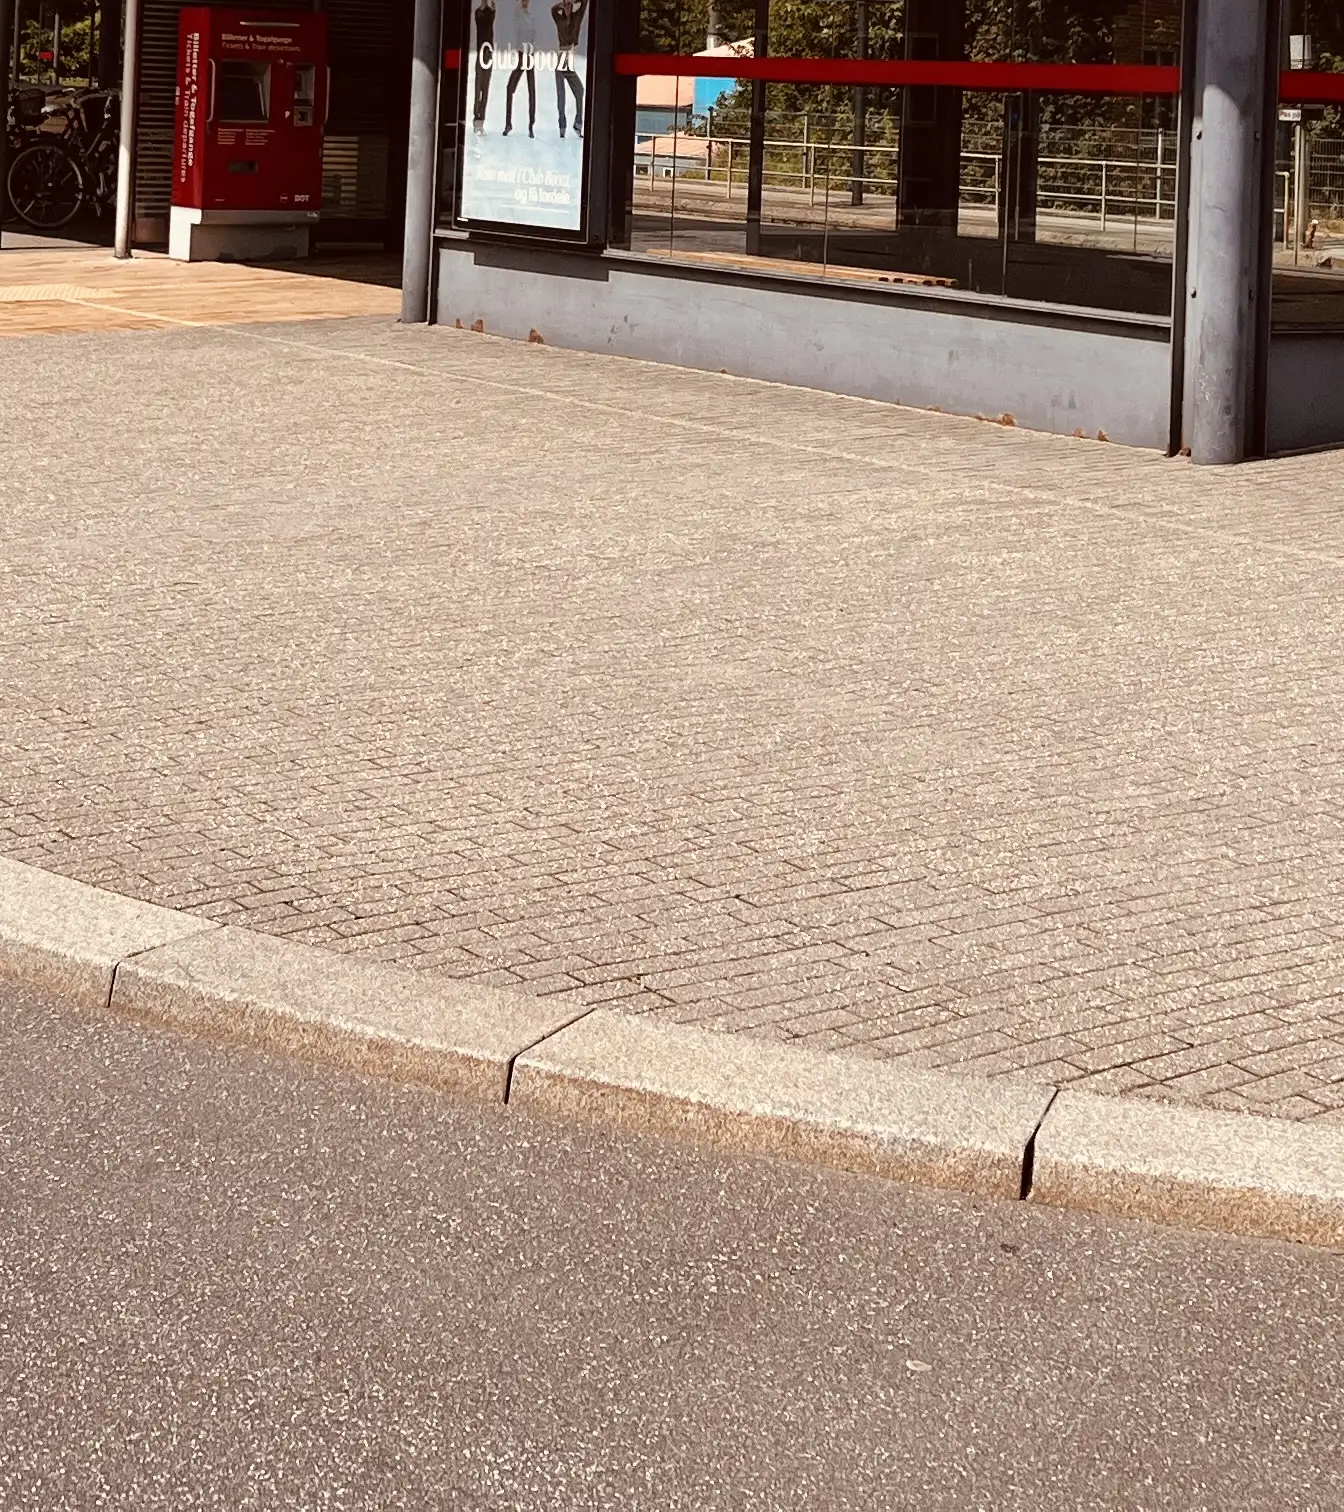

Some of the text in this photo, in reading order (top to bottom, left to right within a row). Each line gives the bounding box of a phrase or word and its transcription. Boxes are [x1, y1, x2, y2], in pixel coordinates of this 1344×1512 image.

[185, 33, 193, 74] Tickets
[191, 32, 200, 81] Billetter
[479, 41, 575, 72] Club Boozt
[183, 89, 191, 117] Train
